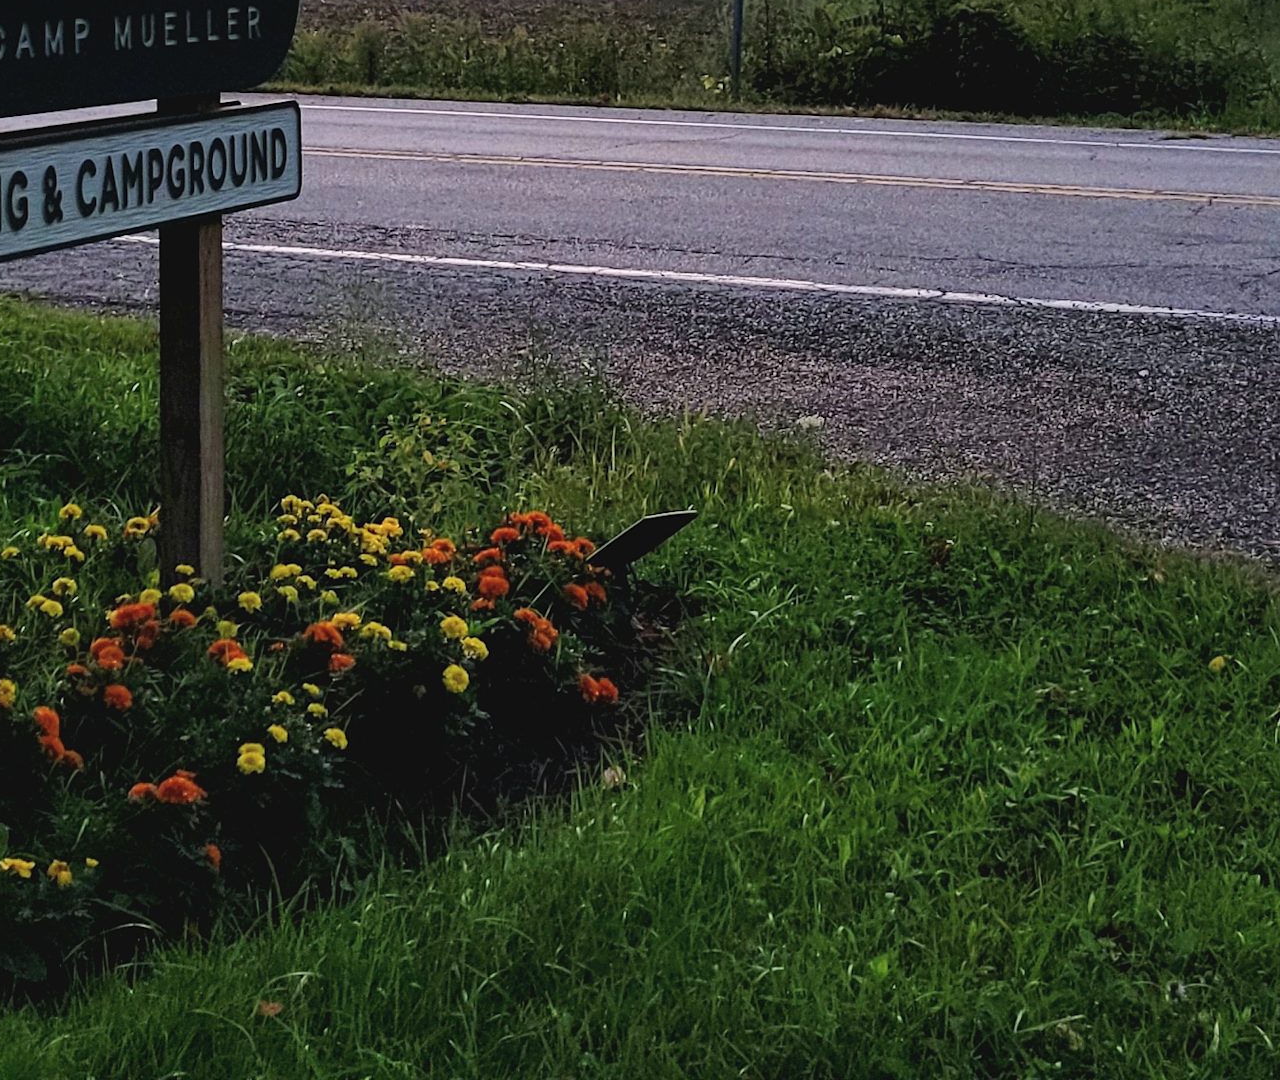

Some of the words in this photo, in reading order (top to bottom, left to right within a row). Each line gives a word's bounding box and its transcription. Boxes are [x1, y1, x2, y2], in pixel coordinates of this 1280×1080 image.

[114, 6, 262, 51] MUELLER
[41, 165, 64, 225] &
[76, 126, 288, 217] CAMPGROUND
